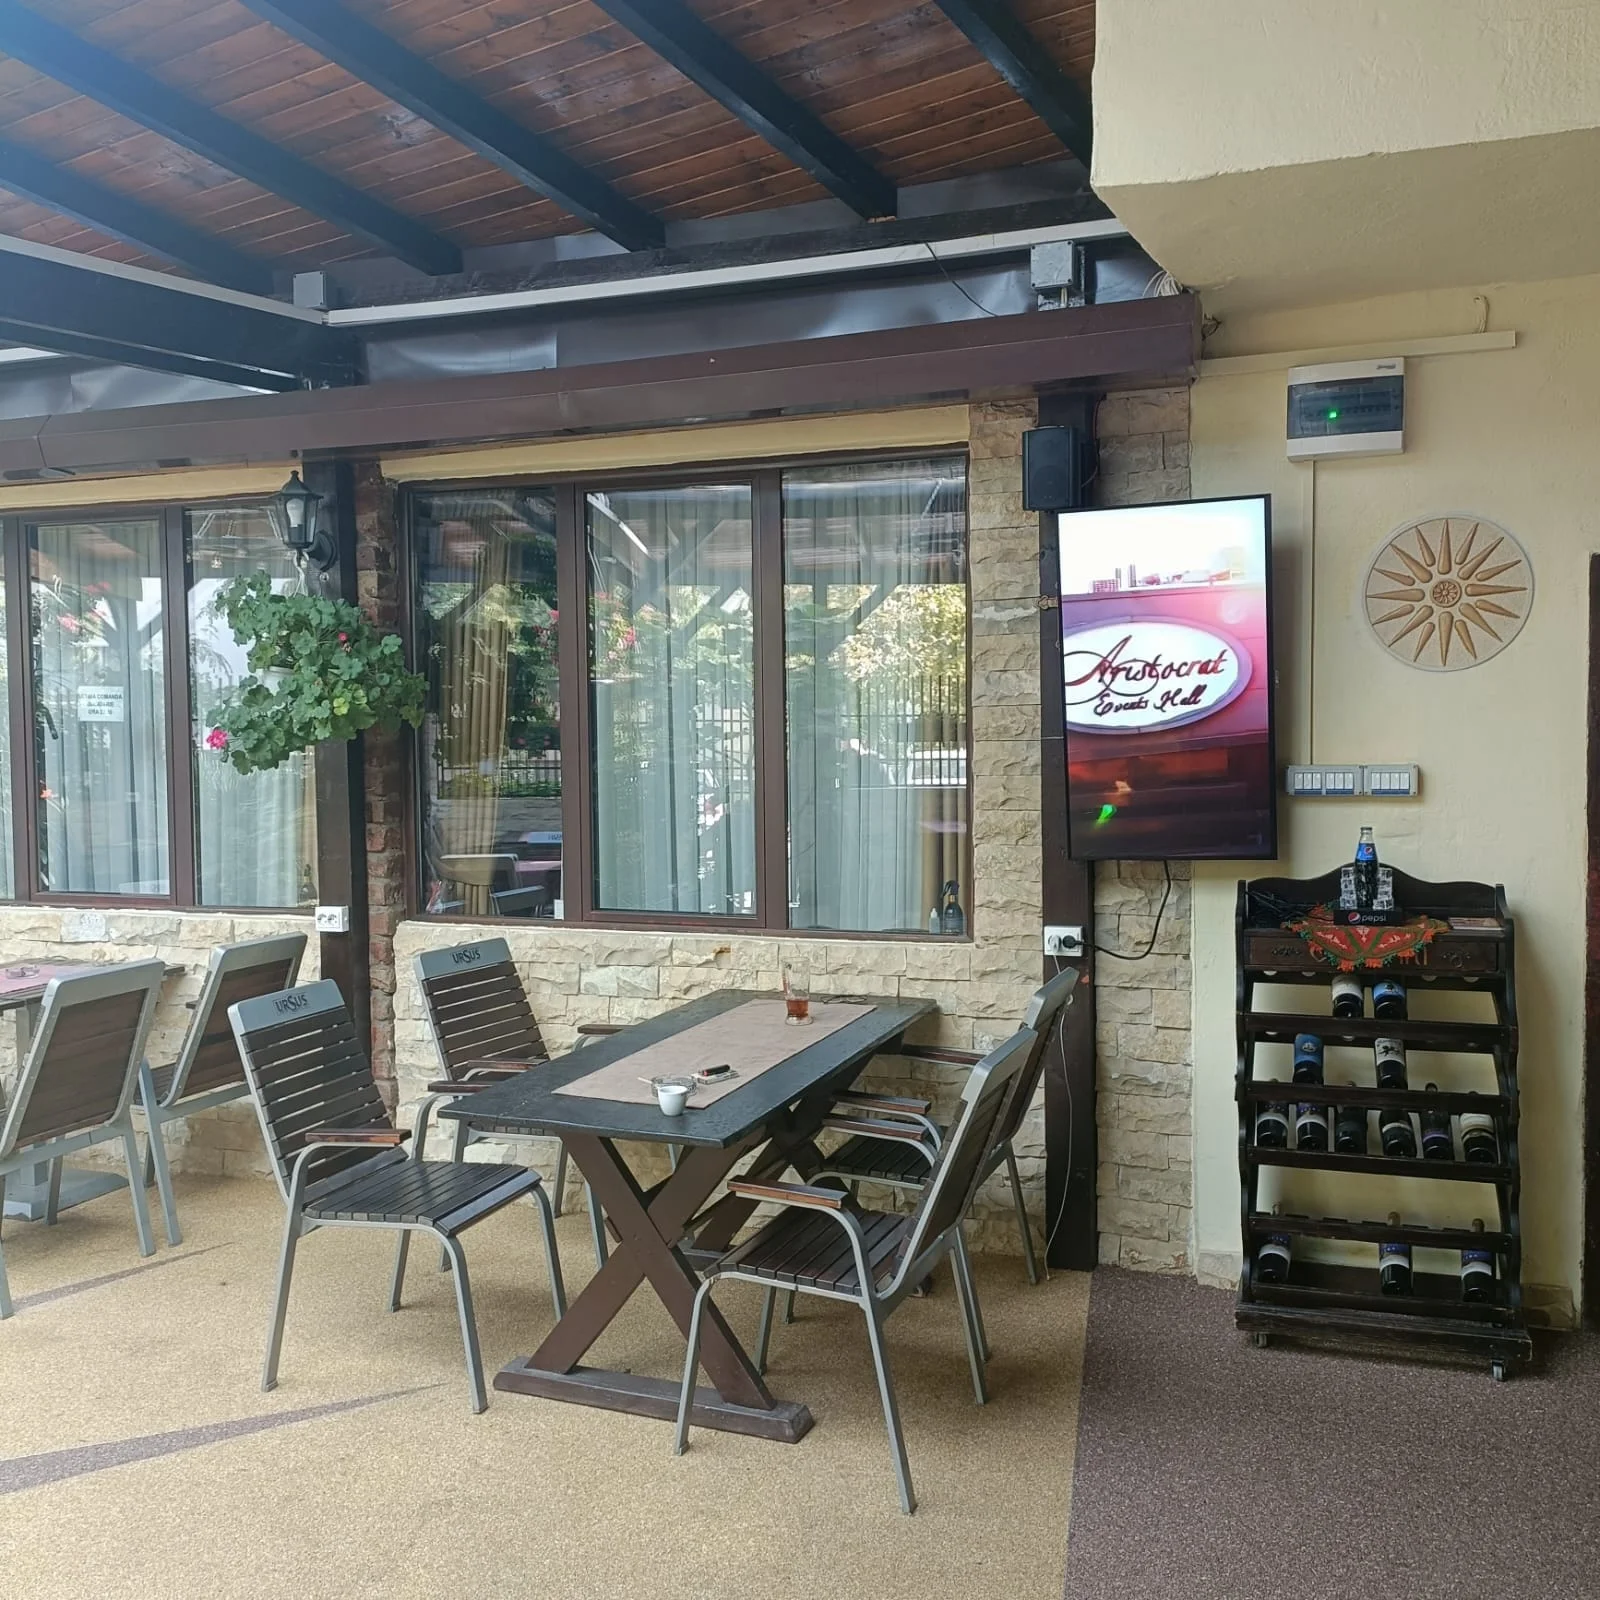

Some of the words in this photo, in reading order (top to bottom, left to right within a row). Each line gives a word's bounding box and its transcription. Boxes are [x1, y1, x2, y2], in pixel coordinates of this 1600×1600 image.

[1066, 635, 1227, 688] Aristocrat
[1094, 692, 1148, 716] Events
[1153, 684, 1207, 713] Hall
[1361, 914, 1387, 923] pepsi
[452, 948, 481, 963] URSUS
[275, 994, 308, 1012] URSUS
